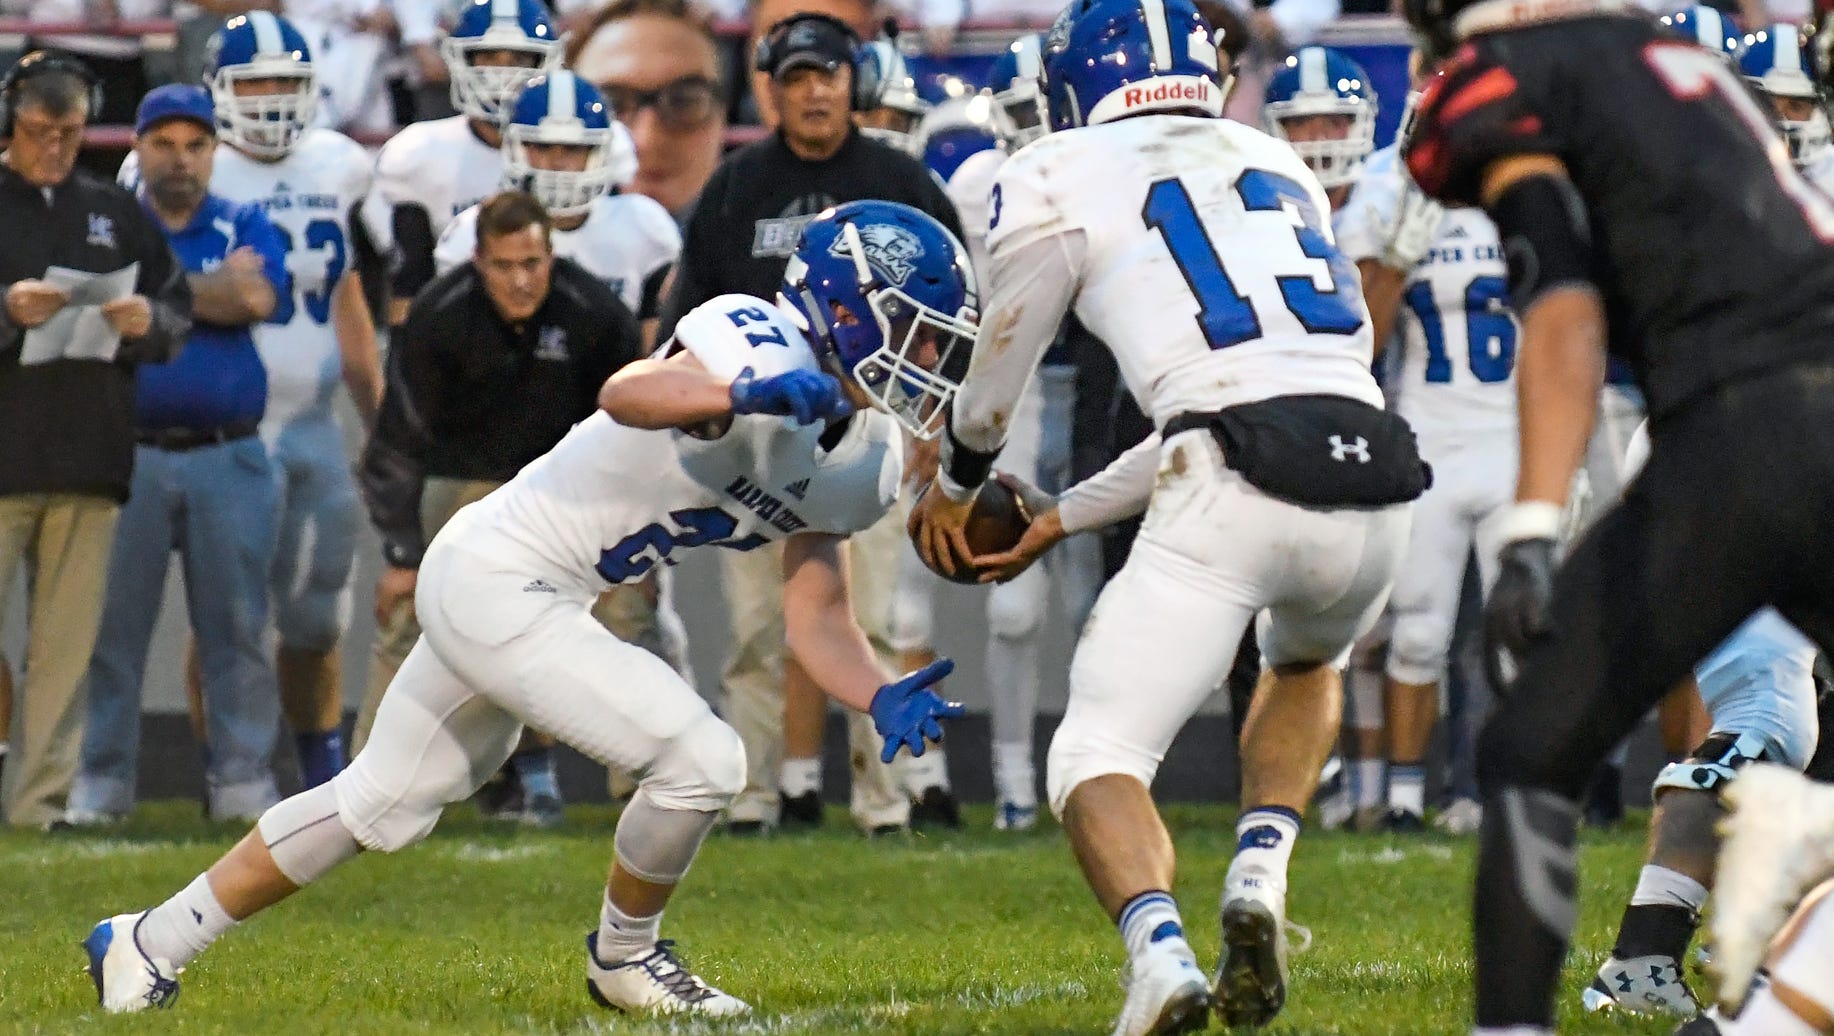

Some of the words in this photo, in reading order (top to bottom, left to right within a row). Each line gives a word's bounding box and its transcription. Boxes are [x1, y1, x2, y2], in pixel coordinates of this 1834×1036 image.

[1124, 81, 1209, 109] Riddell
[1140, 167, 1365, 352] 13
[724, 306, 790, 349] 27
[1403, 275, 1517, 384] 16
